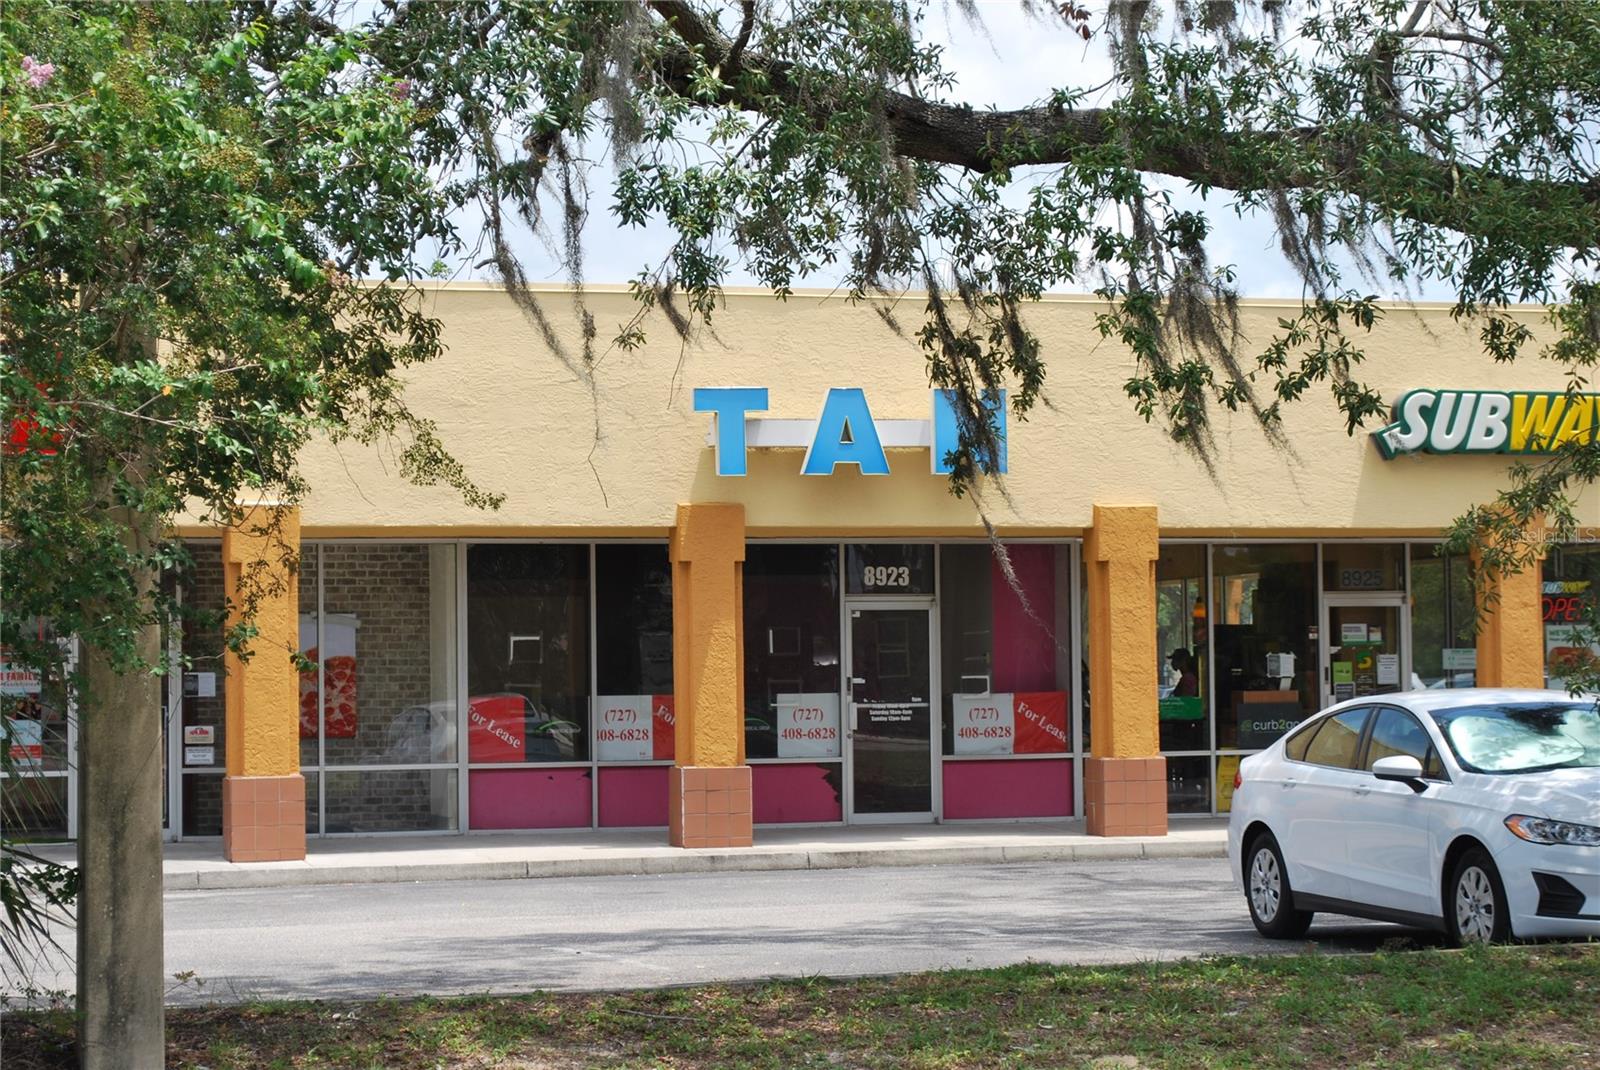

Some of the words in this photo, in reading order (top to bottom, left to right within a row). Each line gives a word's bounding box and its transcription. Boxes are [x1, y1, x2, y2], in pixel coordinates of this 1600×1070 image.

[1382, 391, 1600, 453] SUBWA
[863, 566, 910, 586] 8923
[1342, 570, 1384, 587] 8925
[1541, 597, 1584, 622] OPE
[604, 709, 637, 724] (727)
[792, 708, 824, 722] (727)
[968, 707, 1000, 722] (727)
[1016, 701, 1039, 723] For
[1037, 716, 1068, 744] Lease
[487, 719, 521, 749] Lease
[781, 727, 836, 740] 408-6828
[957, 726, 1012, 739] 408-6828
